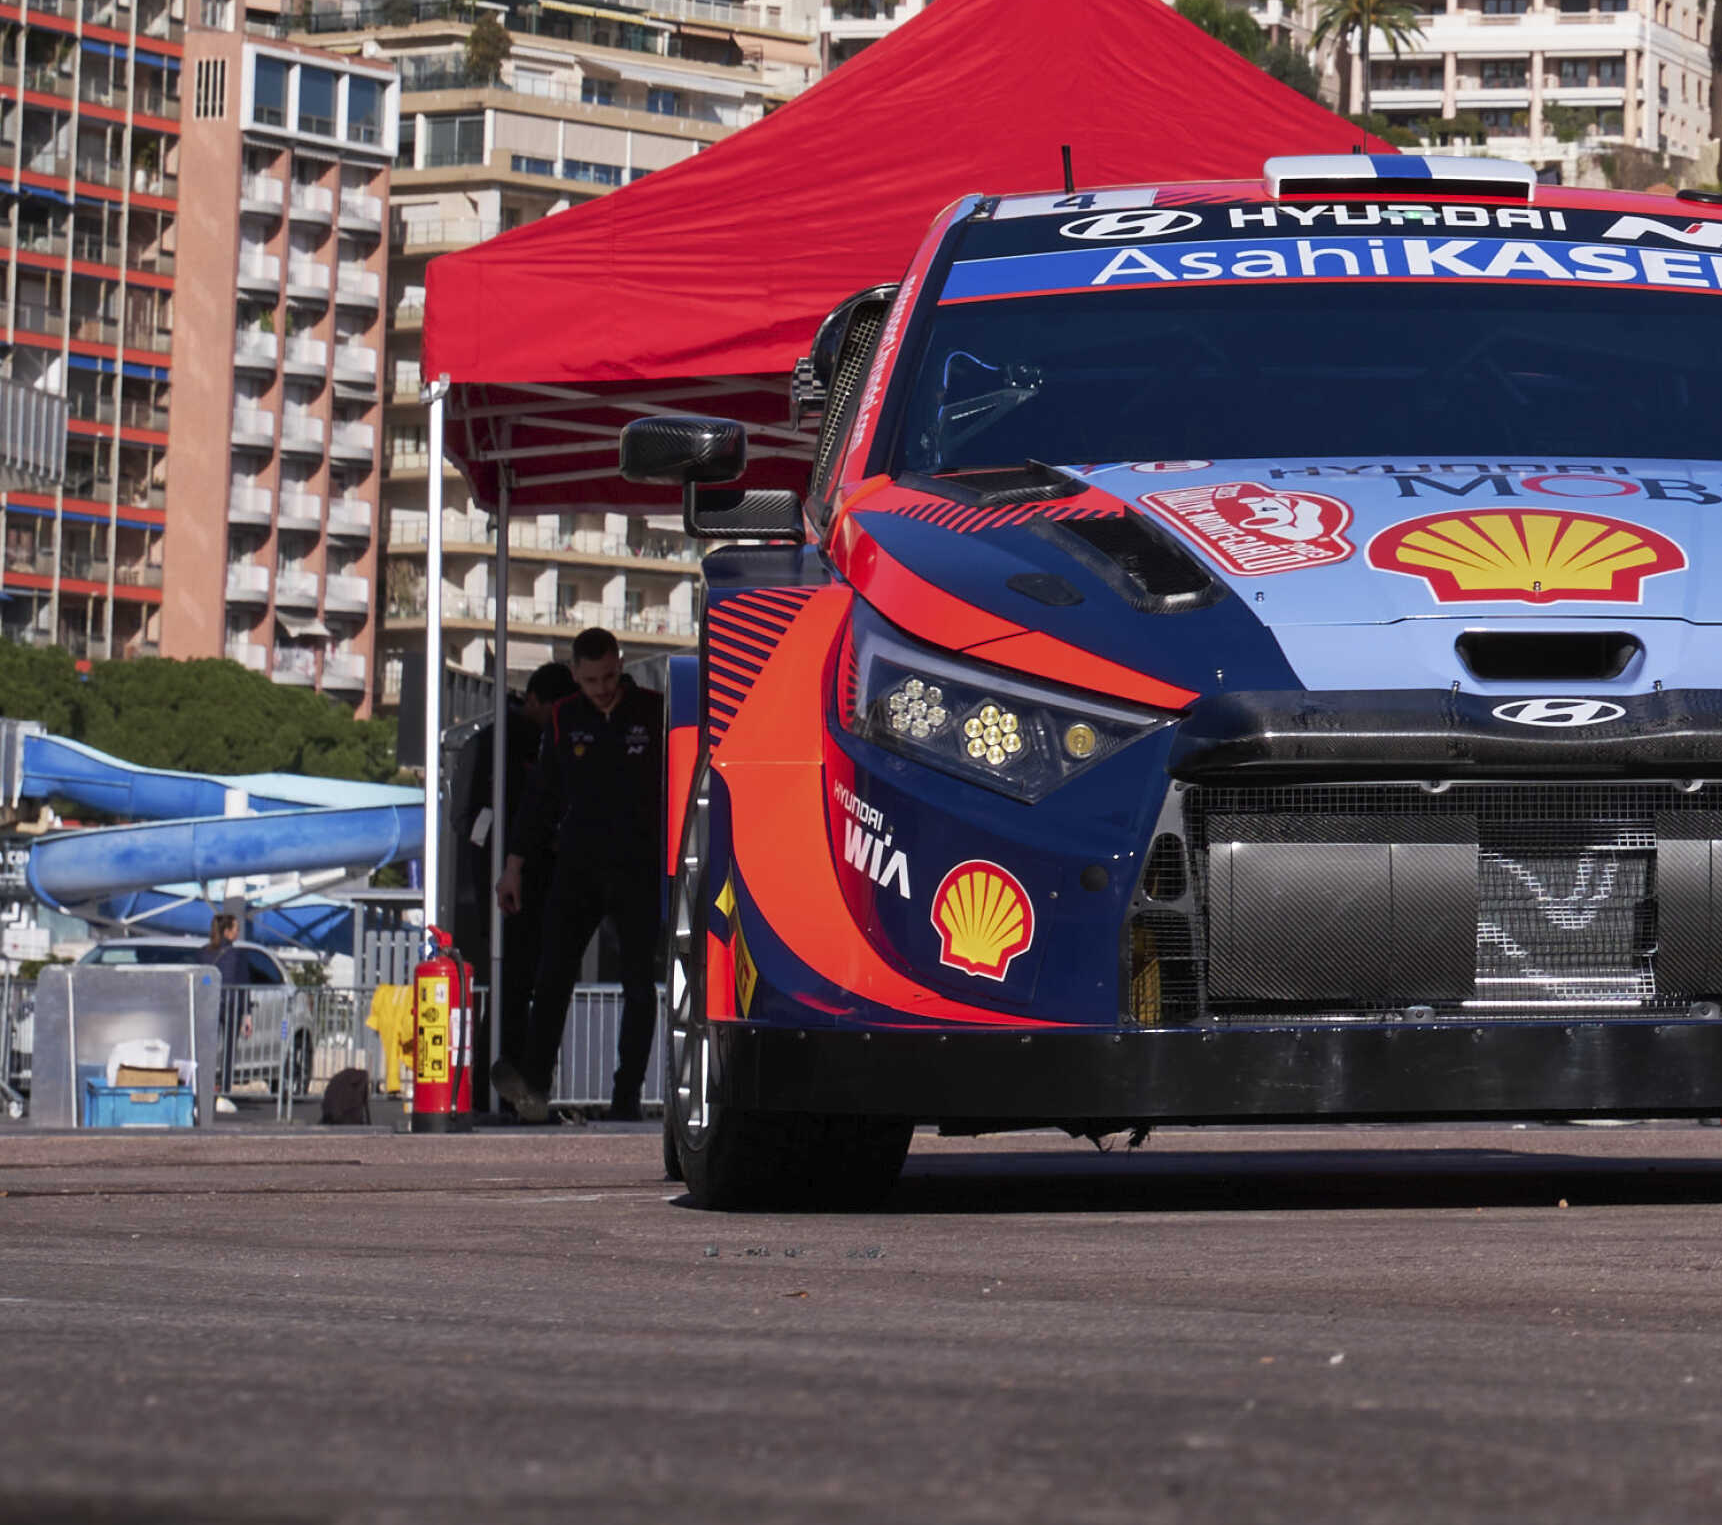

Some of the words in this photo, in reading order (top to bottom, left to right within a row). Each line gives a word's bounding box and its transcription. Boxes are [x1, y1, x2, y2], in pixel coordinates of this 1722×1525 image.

[1053, 192, 1098, 210] 4
[1230, 206, 1566, 231] HYUNDAI
[1271, 463, 1631, 480] HYUNDAI
[834, 779, 884, 832] HYUNDAI
[844, 817, 911, 900] WIA
